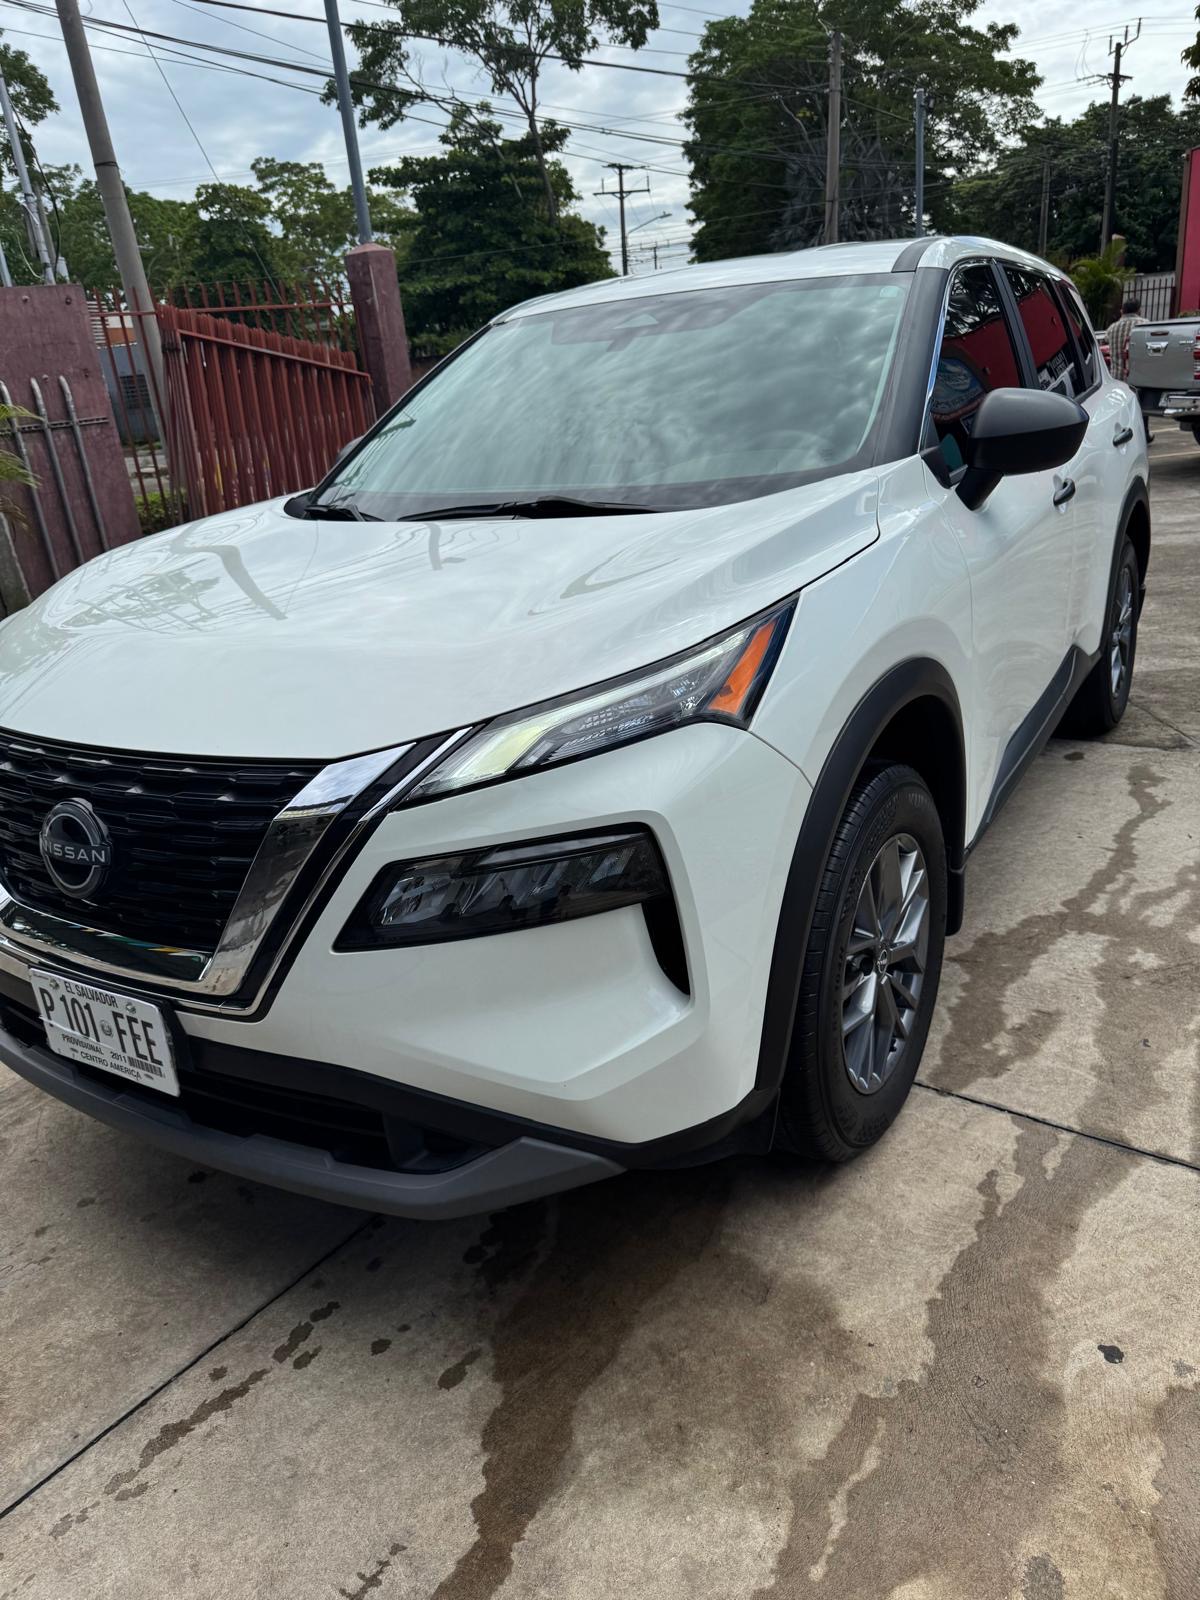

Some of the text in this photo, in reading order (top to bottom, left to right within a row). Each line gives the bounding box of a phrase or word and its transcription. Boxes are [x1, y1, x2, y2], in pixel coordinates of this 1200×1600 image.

[43, 839, 106, 863] NISSAN
[63, 981, 118, 1008] EL SALVADOR
[62, 1034, 127, 1063] PROVISIONAL 2011
[112, 1011, 163, 1067] FEE
[80, 1051, 142, 1079] CENTRO AMERICA
